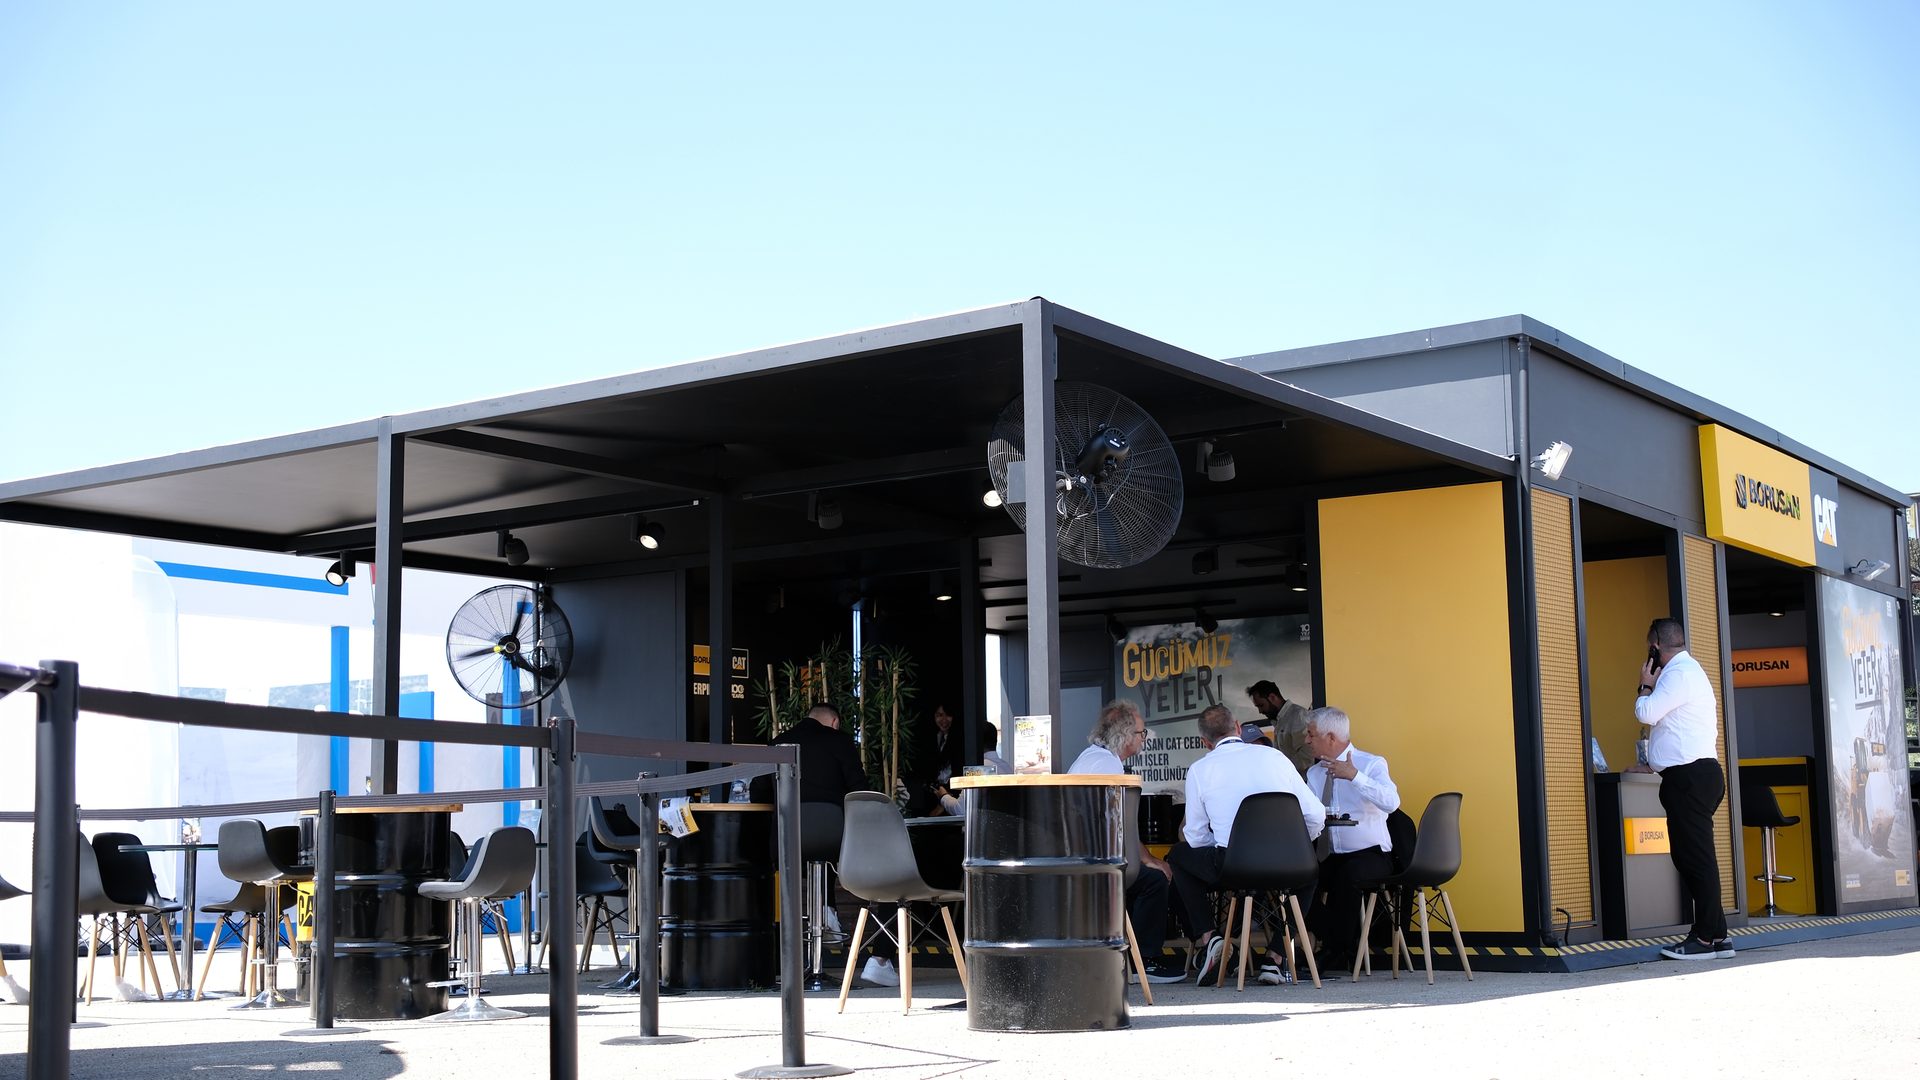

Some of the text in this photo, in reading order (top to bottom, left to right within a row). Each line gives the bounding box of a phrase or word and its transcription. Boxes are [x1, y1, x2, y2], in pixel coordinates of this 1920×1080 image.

[1749, 478, 1800, 520] BORUSAN
[1814, 494, 1838, 547] CAT
[694, 656, 710, 664] BORU
[732, 656, 746, 670] CAT
[1123, 633, 1232, 688] GÜCÜMÜZ
[1166, 737, 1182, 751] CAT
[1145, 751, 1169, 768] İŞLER
[299, 895, 314, 927] CA
